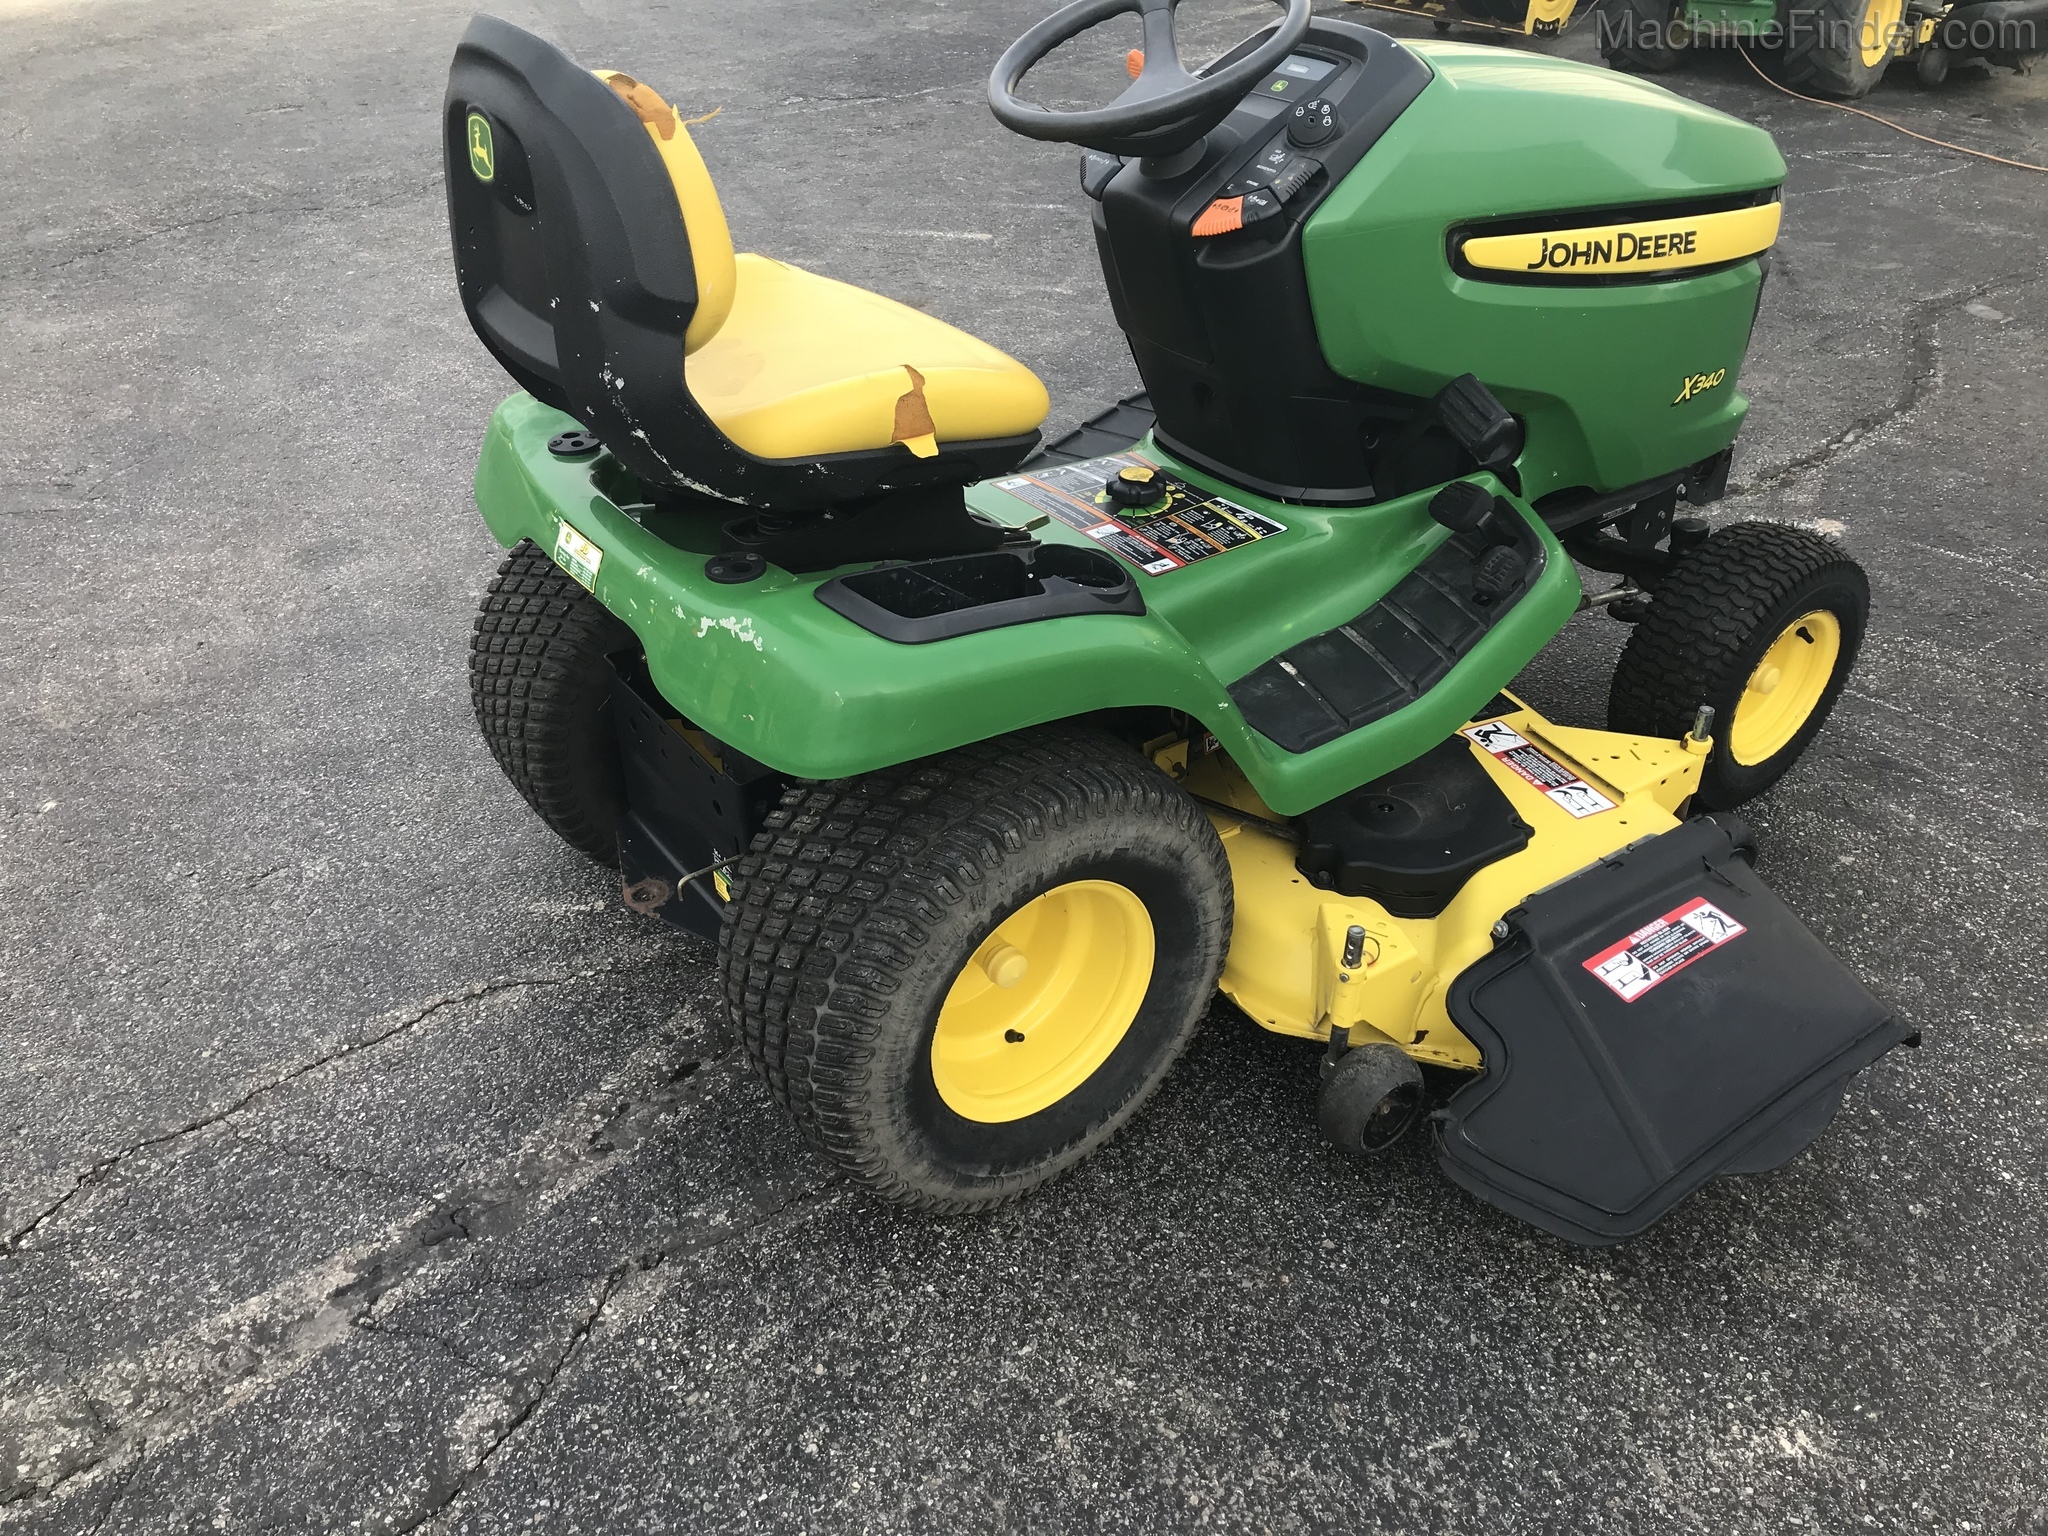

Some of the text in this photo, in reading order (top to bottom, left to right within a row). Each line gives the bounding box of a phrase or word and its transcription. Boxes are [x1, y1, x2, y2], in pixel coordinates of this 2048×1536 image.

[1527, 230, 1698, 270] JOHN DEERE
[1672, 367, 1726, 405] X340
[1501, 756, 1535, 781] DANGER
[1634, 918, 1669, 939] DANGER
